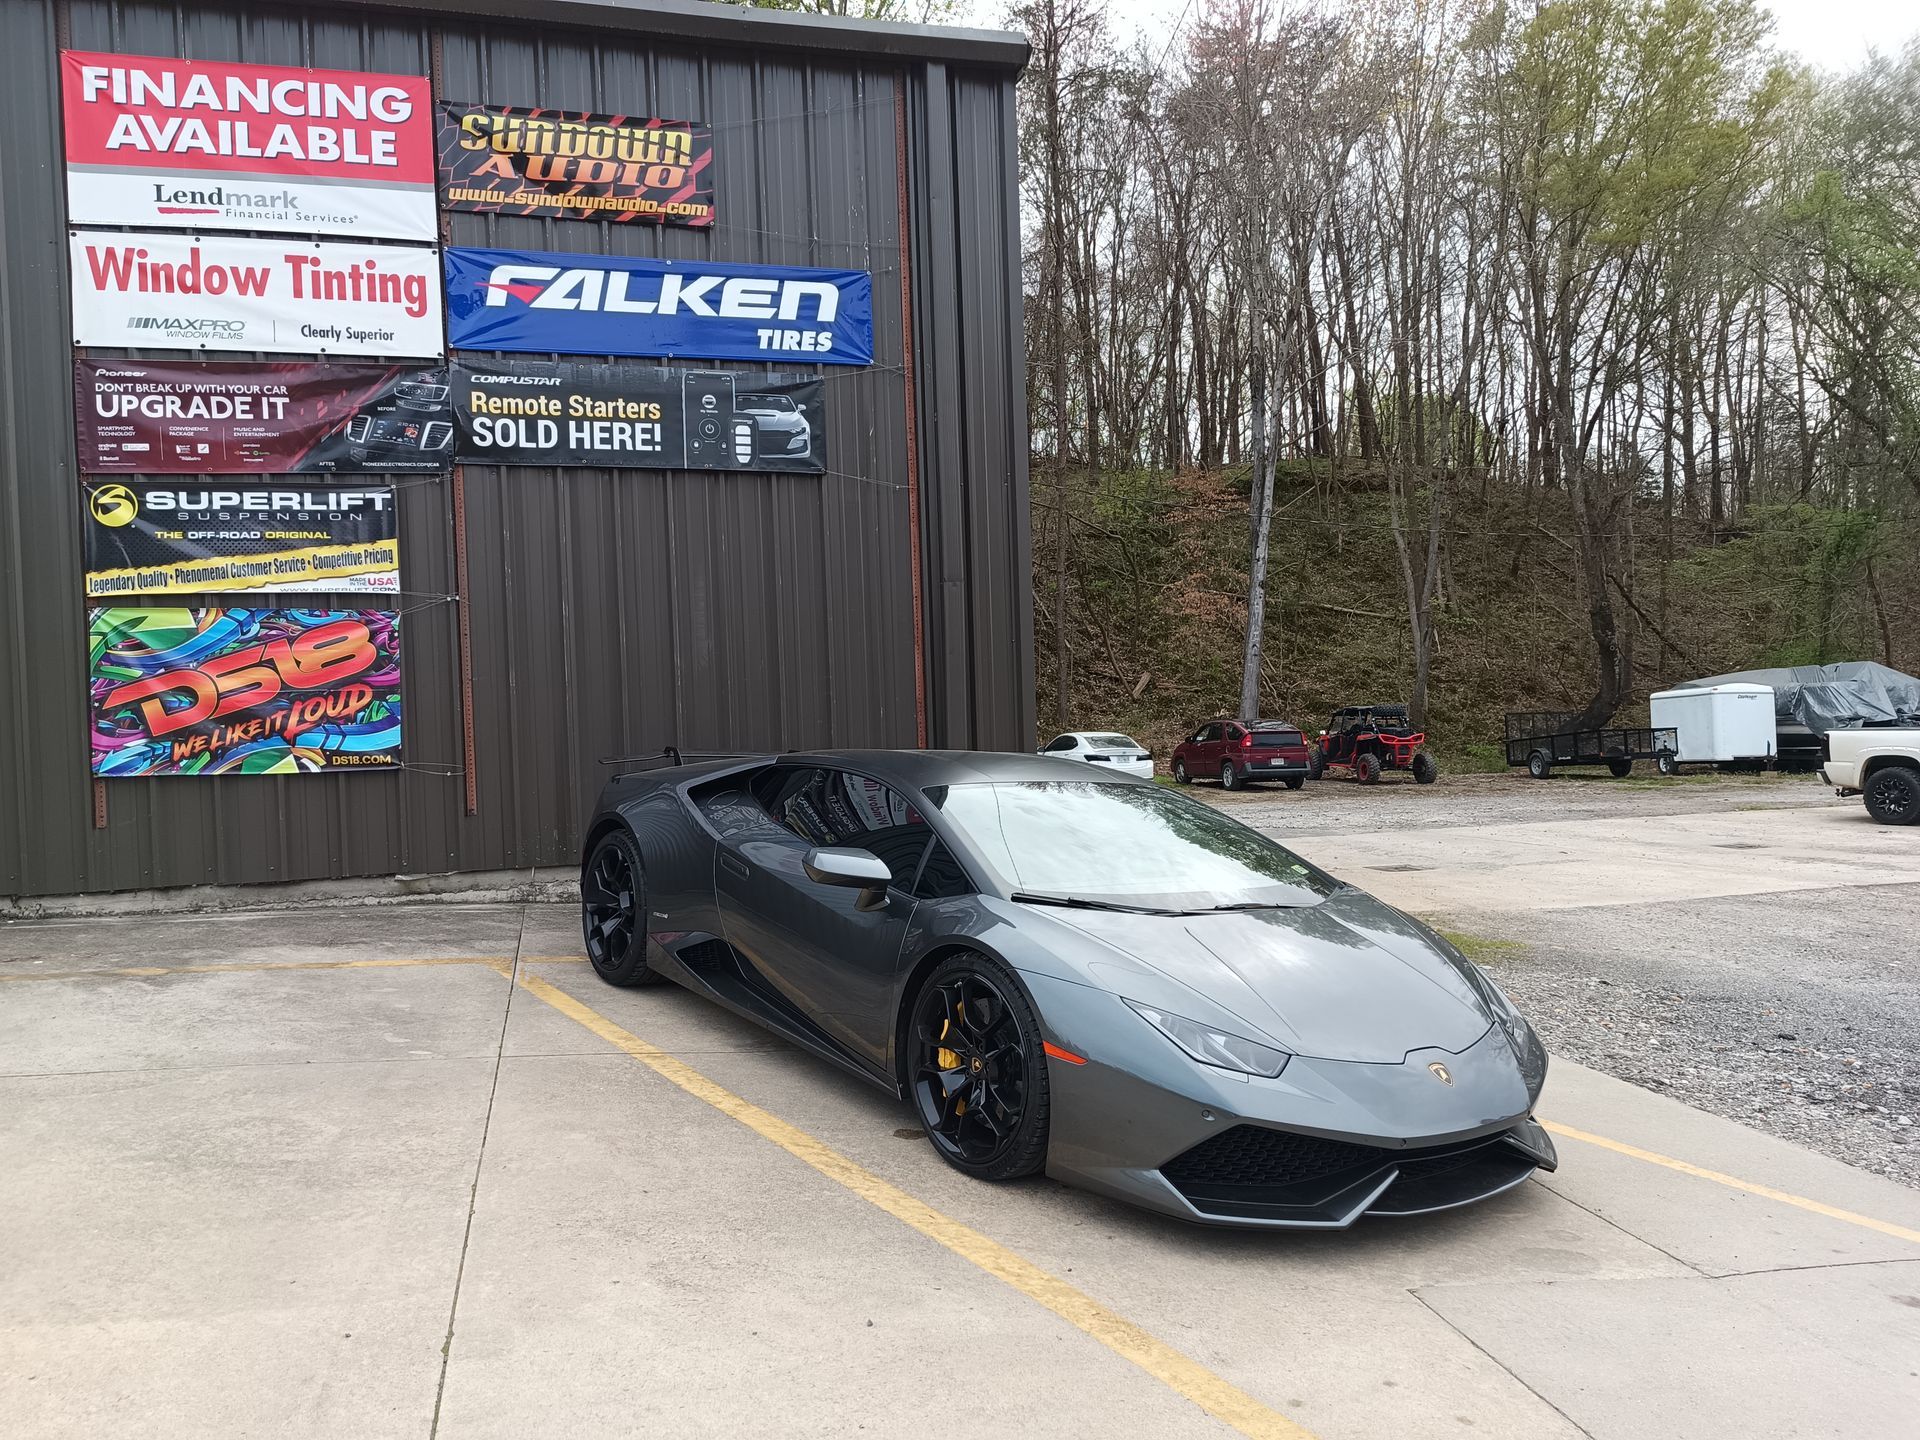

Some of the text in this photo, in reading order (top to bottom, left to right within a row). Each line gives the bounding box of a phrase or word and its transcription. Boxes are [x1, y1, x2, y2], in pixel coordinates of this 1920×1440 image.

[82, 66, 412, 123] FINANCING
[106, 113, 398, 166] AVAILABLE
[469, 154, 686, 189] AUDIO
[153, 183, 298, 209] Lendmark
[448, 188, 709, 217] www.sundownaudio.com
[225, 208, 289, 220] Financial
[85, 245, 428, 318] Window Tinting
[484, 264, 840, 322] FALKEN
[150, 317, 246, 332] MAXPRO
[166, 330, 244, 340] WINDOW FILMS
[300, 323, 395, 343] Clearly Superior
[757, 328, 833, 352] TIRES
[95, 368, 148, 377] Pioneer
[470, 374, 563, 386] COMPUSTAR
[95, 382, 288, 395] DON'T BREAK UP WITH YOUR CAR
[95, 394, 290, 420] UPGRADE IT
[470, 391, 662, 420] Remote Starters
[472, 416, 662, 451] SOLD HERE!
[145, 491, 392, 511] SUPERLIFT
[177, 512, 363, 521] SUSPENSION
[155, 531, 332, 539] THE OFF-ROAD ORIGINAL
[89, 548, 394, 594] Legendary Quality Phenomenal Customer Service Competitive Pricing
[367, 577, 394, 586] USA
[102, 619, 377, 737] DS18
[171, 682, 373, 762] WE LIKE IT LOUD
[332, 754, 392, 766] DS18.COM
